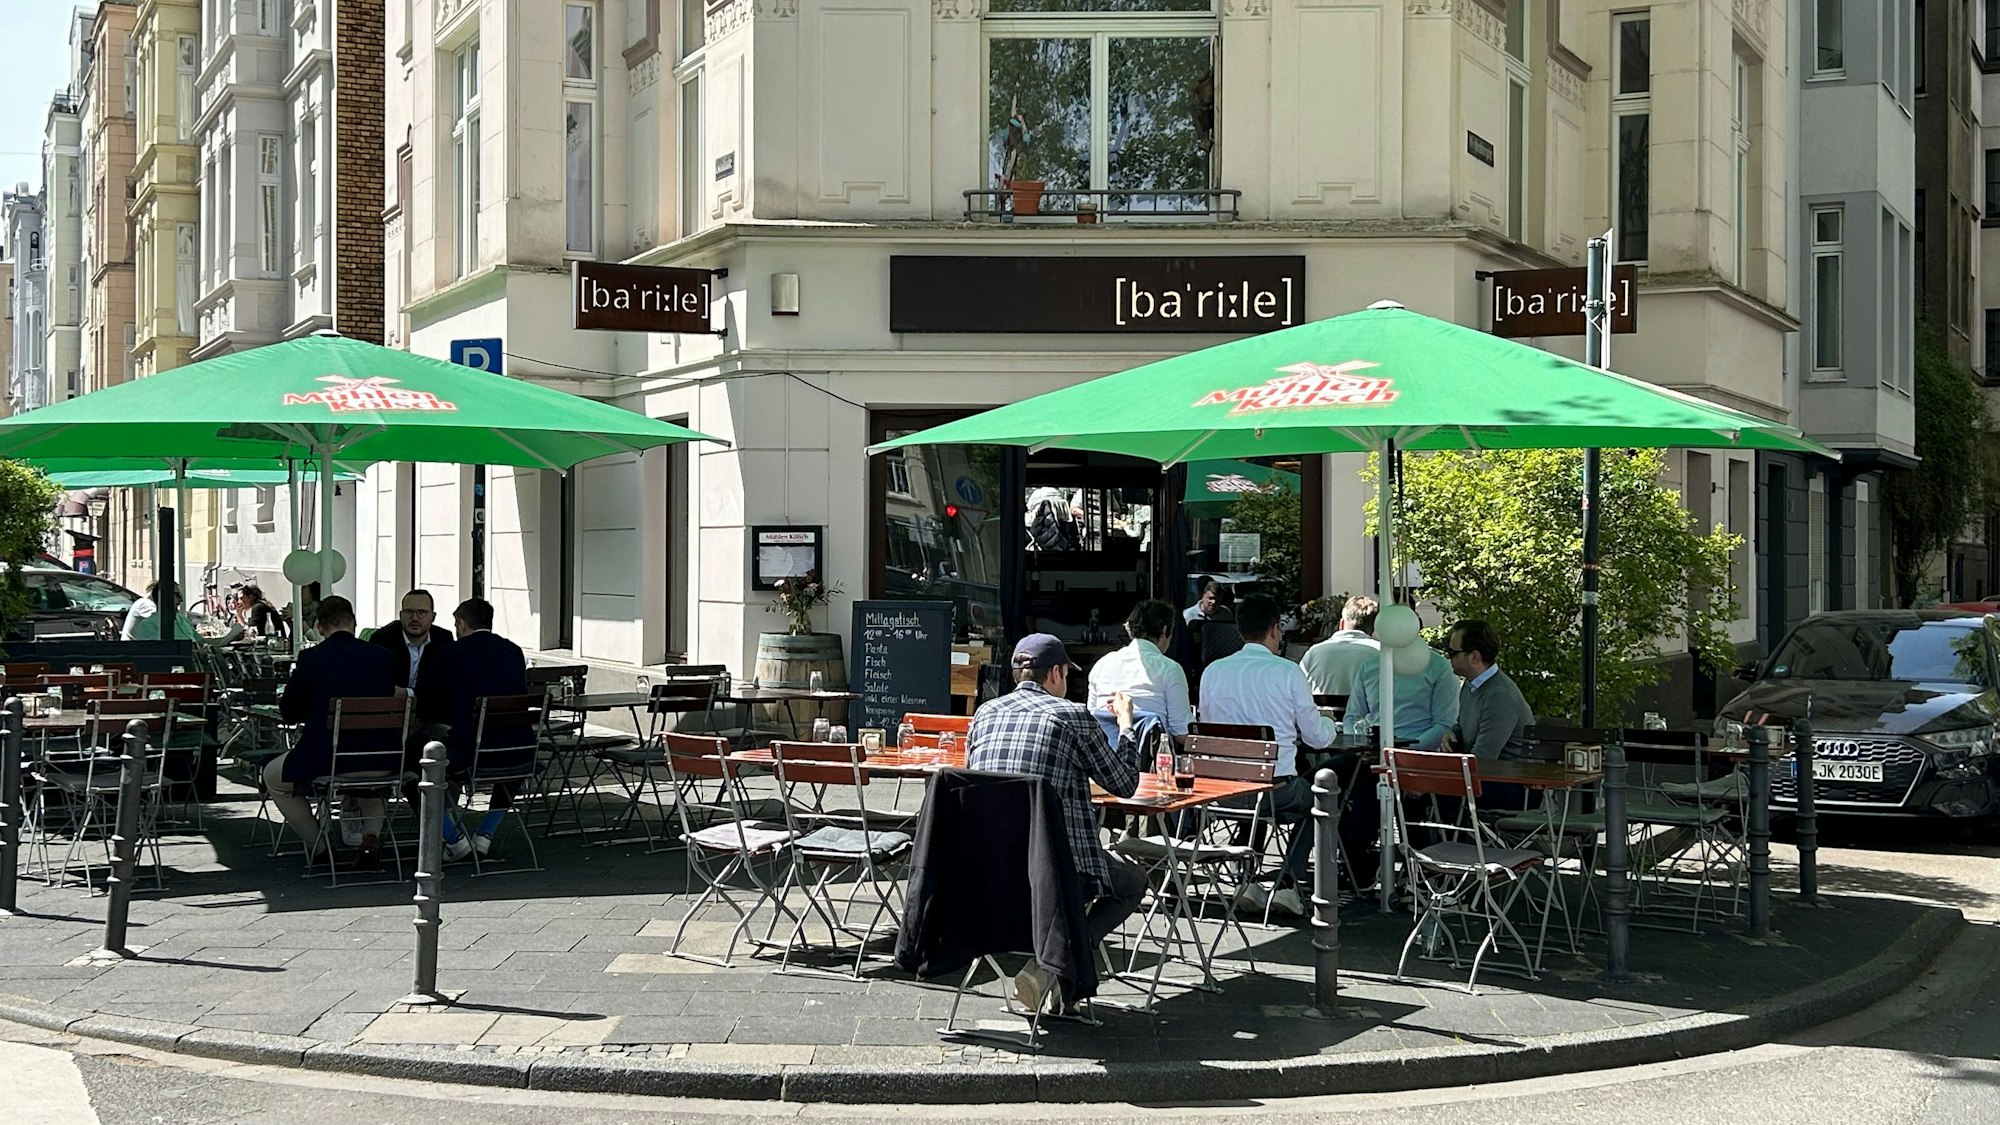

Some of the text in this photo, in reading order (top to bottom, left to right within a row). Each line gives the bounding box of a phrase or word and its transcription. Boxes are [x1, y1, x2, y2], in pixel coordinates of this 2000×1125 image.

[865, 612, 921, 630] Mittagstisch
[915, 630, 928, 640] Uhr
[865, 642, 889, 654] Pasta
[865, 655, 887, 667] Fisch
[864, 668, 892, 680] Fleisch
[864, 681, 889, 693] Salate
[865, 718, 873, 728] ab
[1839, 764, 1881, 780] 2030E
